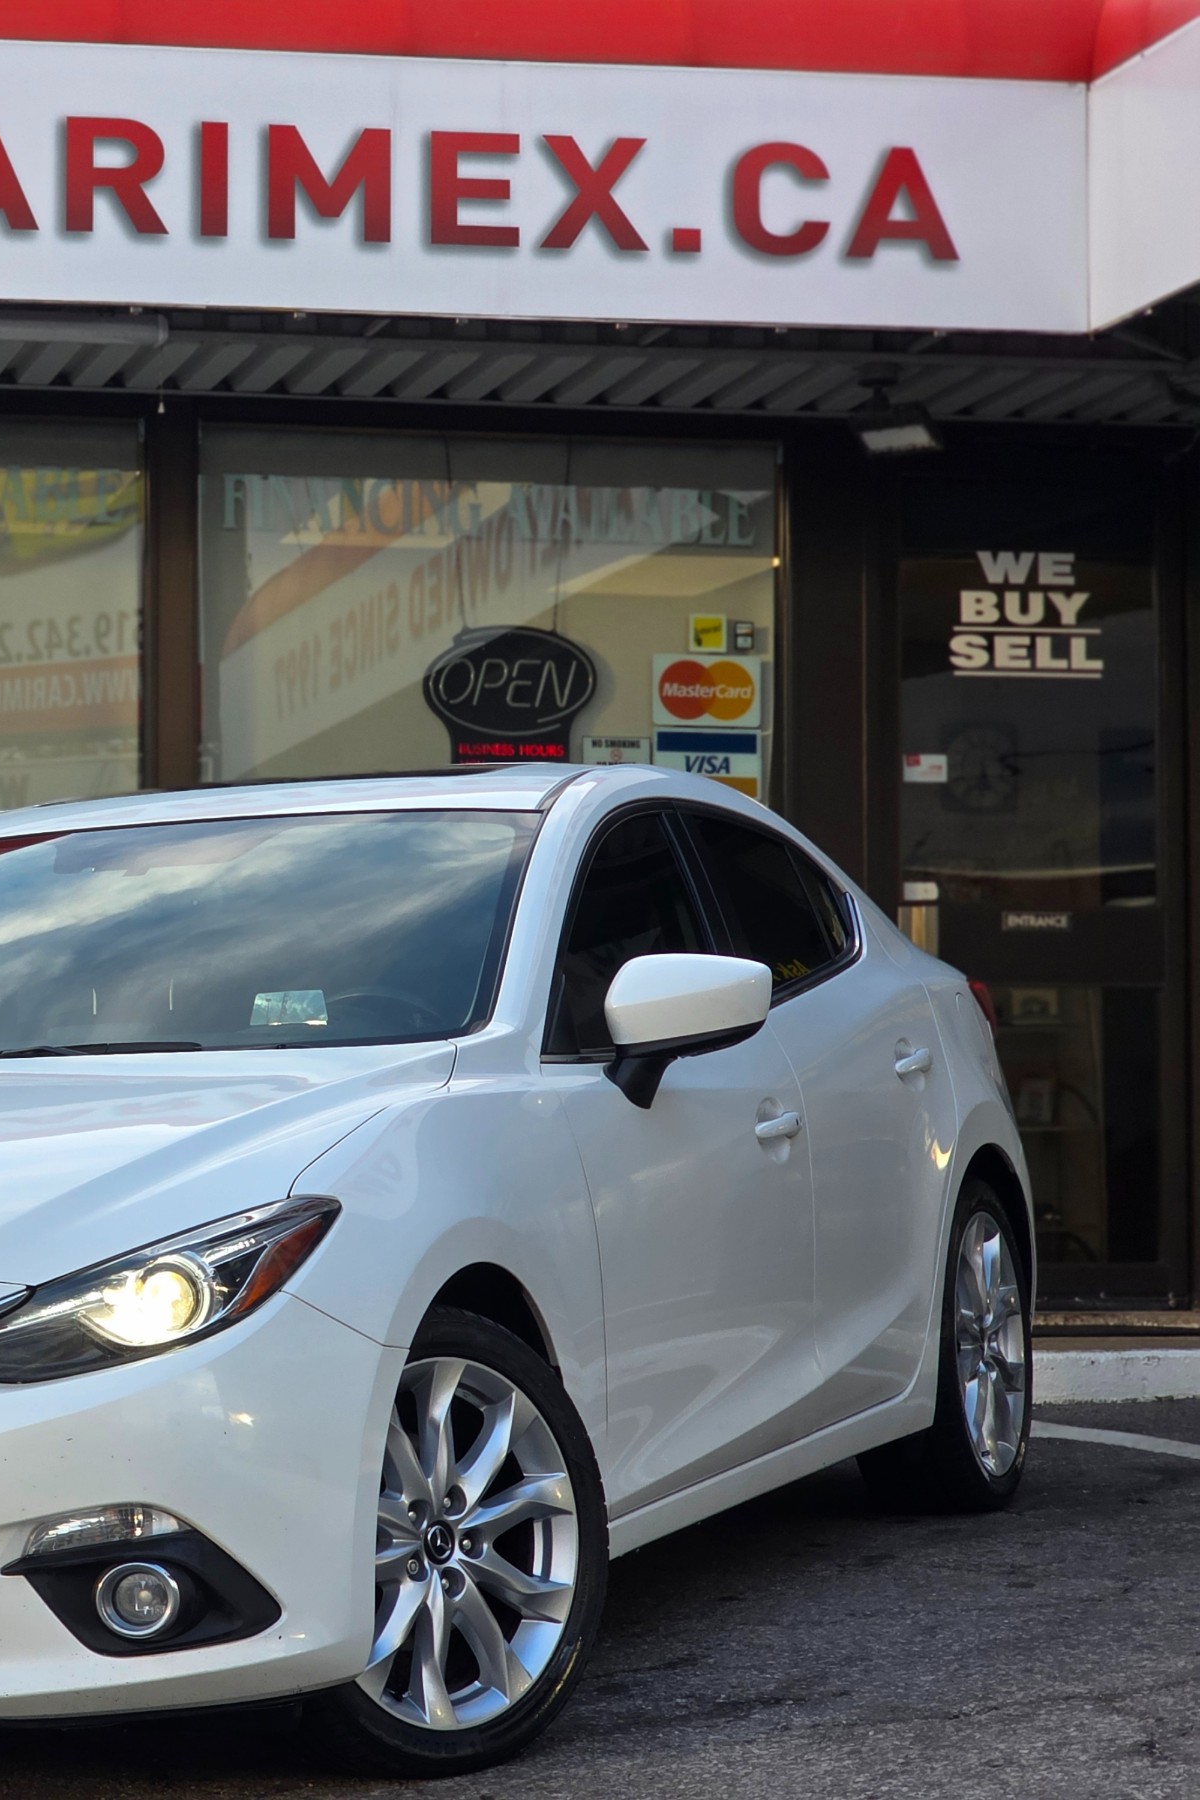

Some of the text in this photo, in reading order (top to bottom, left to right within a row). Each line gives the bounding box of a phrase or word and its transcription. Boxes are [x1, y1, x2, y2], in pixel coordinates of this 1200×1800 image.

[223, 474, 481, 537] FINANCING
[504, 483, 754, 546] AVAILABLE
[977, 550, 1075, 586] WE
[960, 590, 1090, 626] BUY
[949, 634, 1104, 670] SELL
[440, 657, 577, 708] OPEN
[662, 681, 753, 699] MasterCard
[458, 743, 564, 757] BUSINESS HOURS
[592, 739, 640, 749] NO SMOKING
[685, 755, 730, 774] VISA
[1007, 914, 1068, 928] ENTRANCE
